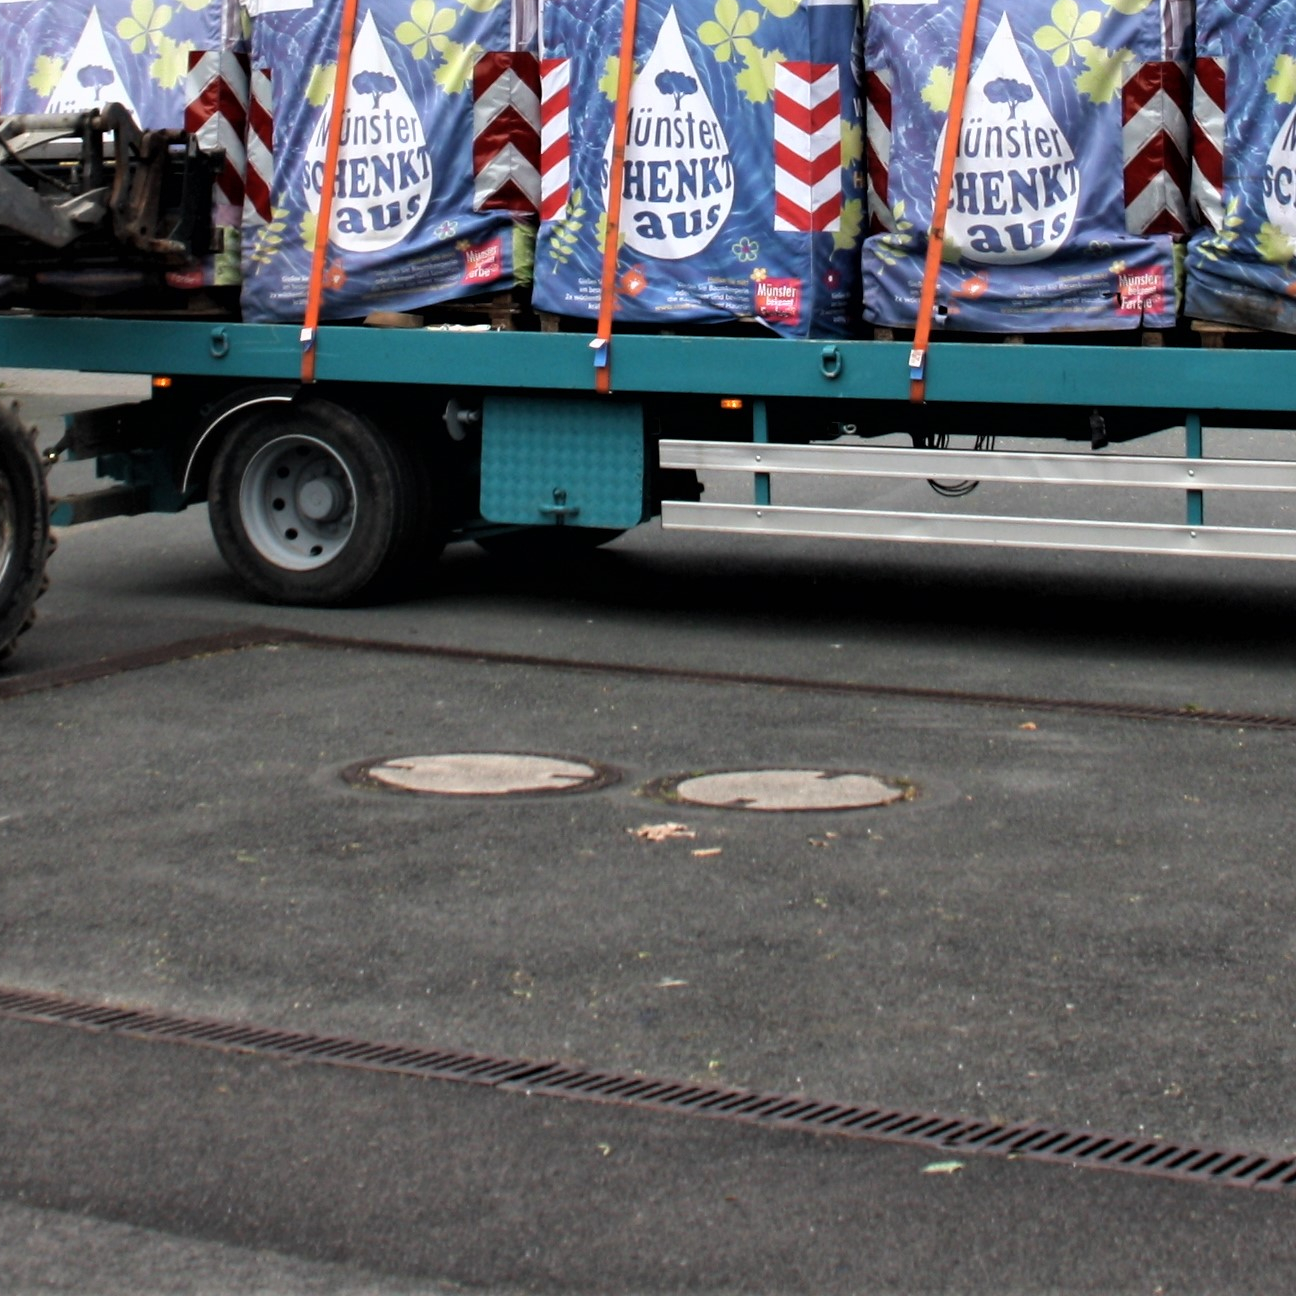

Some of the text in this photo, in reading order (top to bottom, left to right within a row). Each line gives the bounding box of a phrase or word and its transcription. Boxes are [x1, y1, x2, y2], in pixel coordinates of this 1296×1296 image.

[956, 117, 1063, 158] ünster
[600, 154, 733, 203] SHENKT
[933, 162, 1077, 216] HENKT
[336, 193, 421, 234] aus
[633, 203, 721, 240] aus
[967, 212, 1067, 253] aus
[757, 283, 797, 298] Münster
[1118, 273, 1160, 287] Münster
